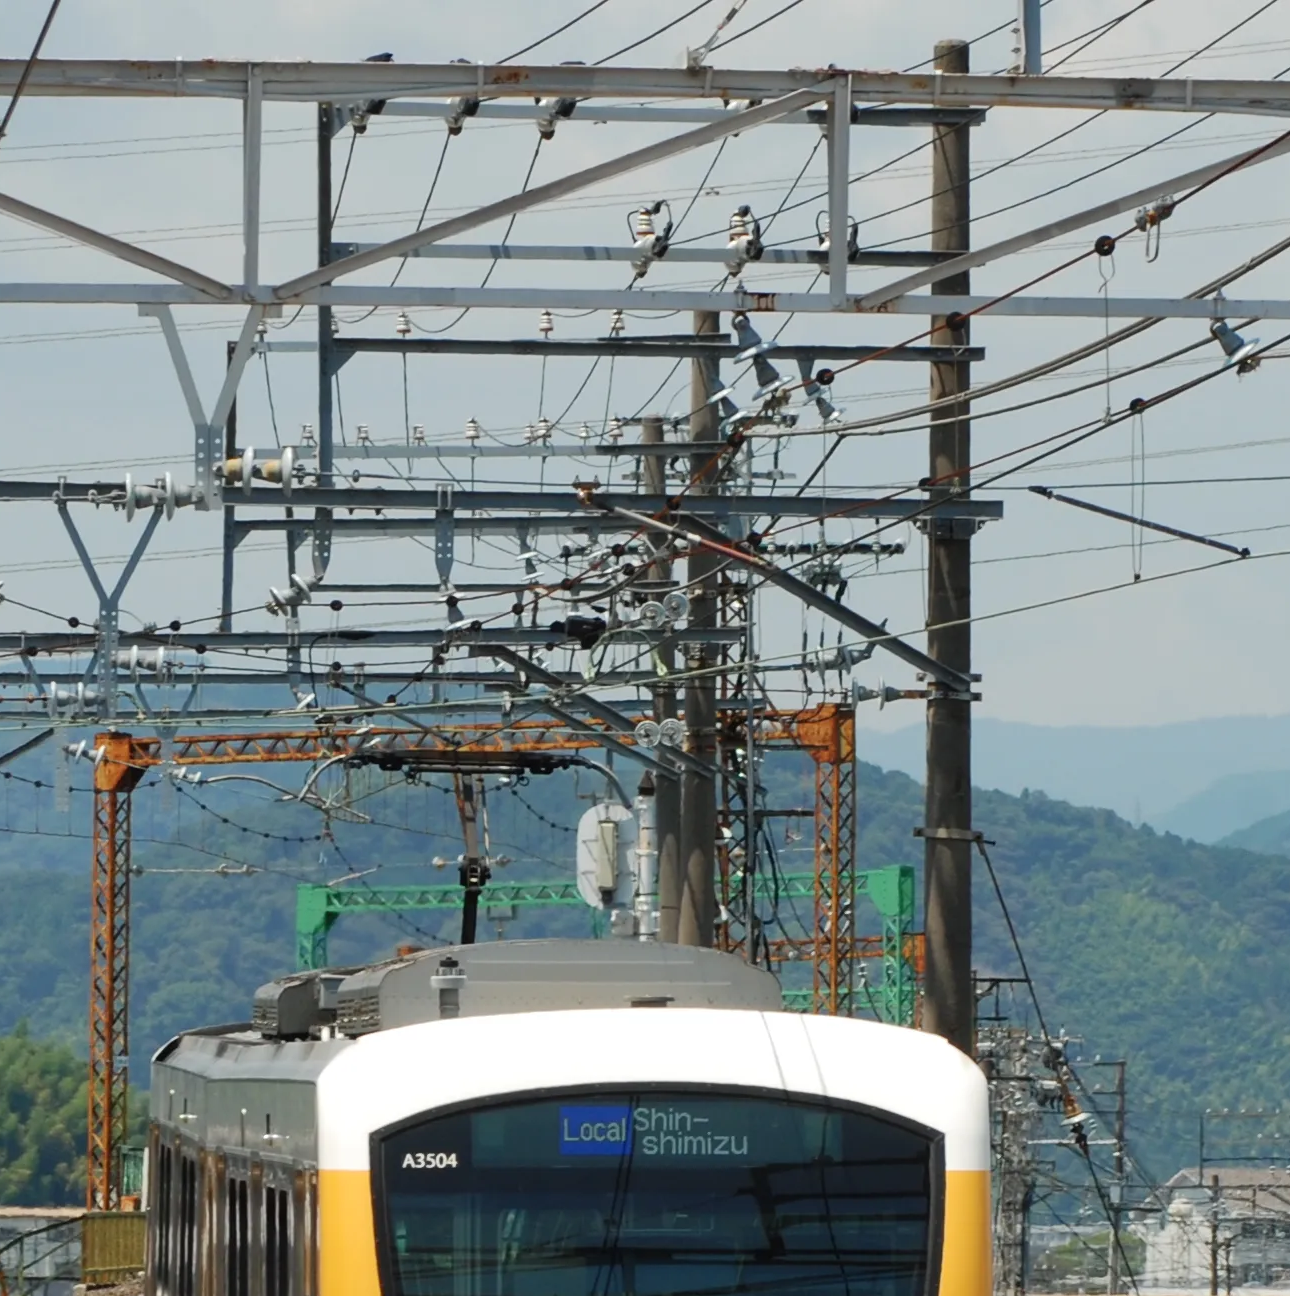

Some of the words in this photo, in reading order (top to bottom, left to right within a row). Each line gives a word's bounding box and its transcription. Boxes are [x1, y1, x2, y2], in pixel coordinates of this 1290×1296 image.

[562, 1117, 627, 1143] Local
[633, 1107, 709, 1132] Shin-
[641, 1132, 748, 1156] shimizu
[401, 1153, 458, 1169] A3504
